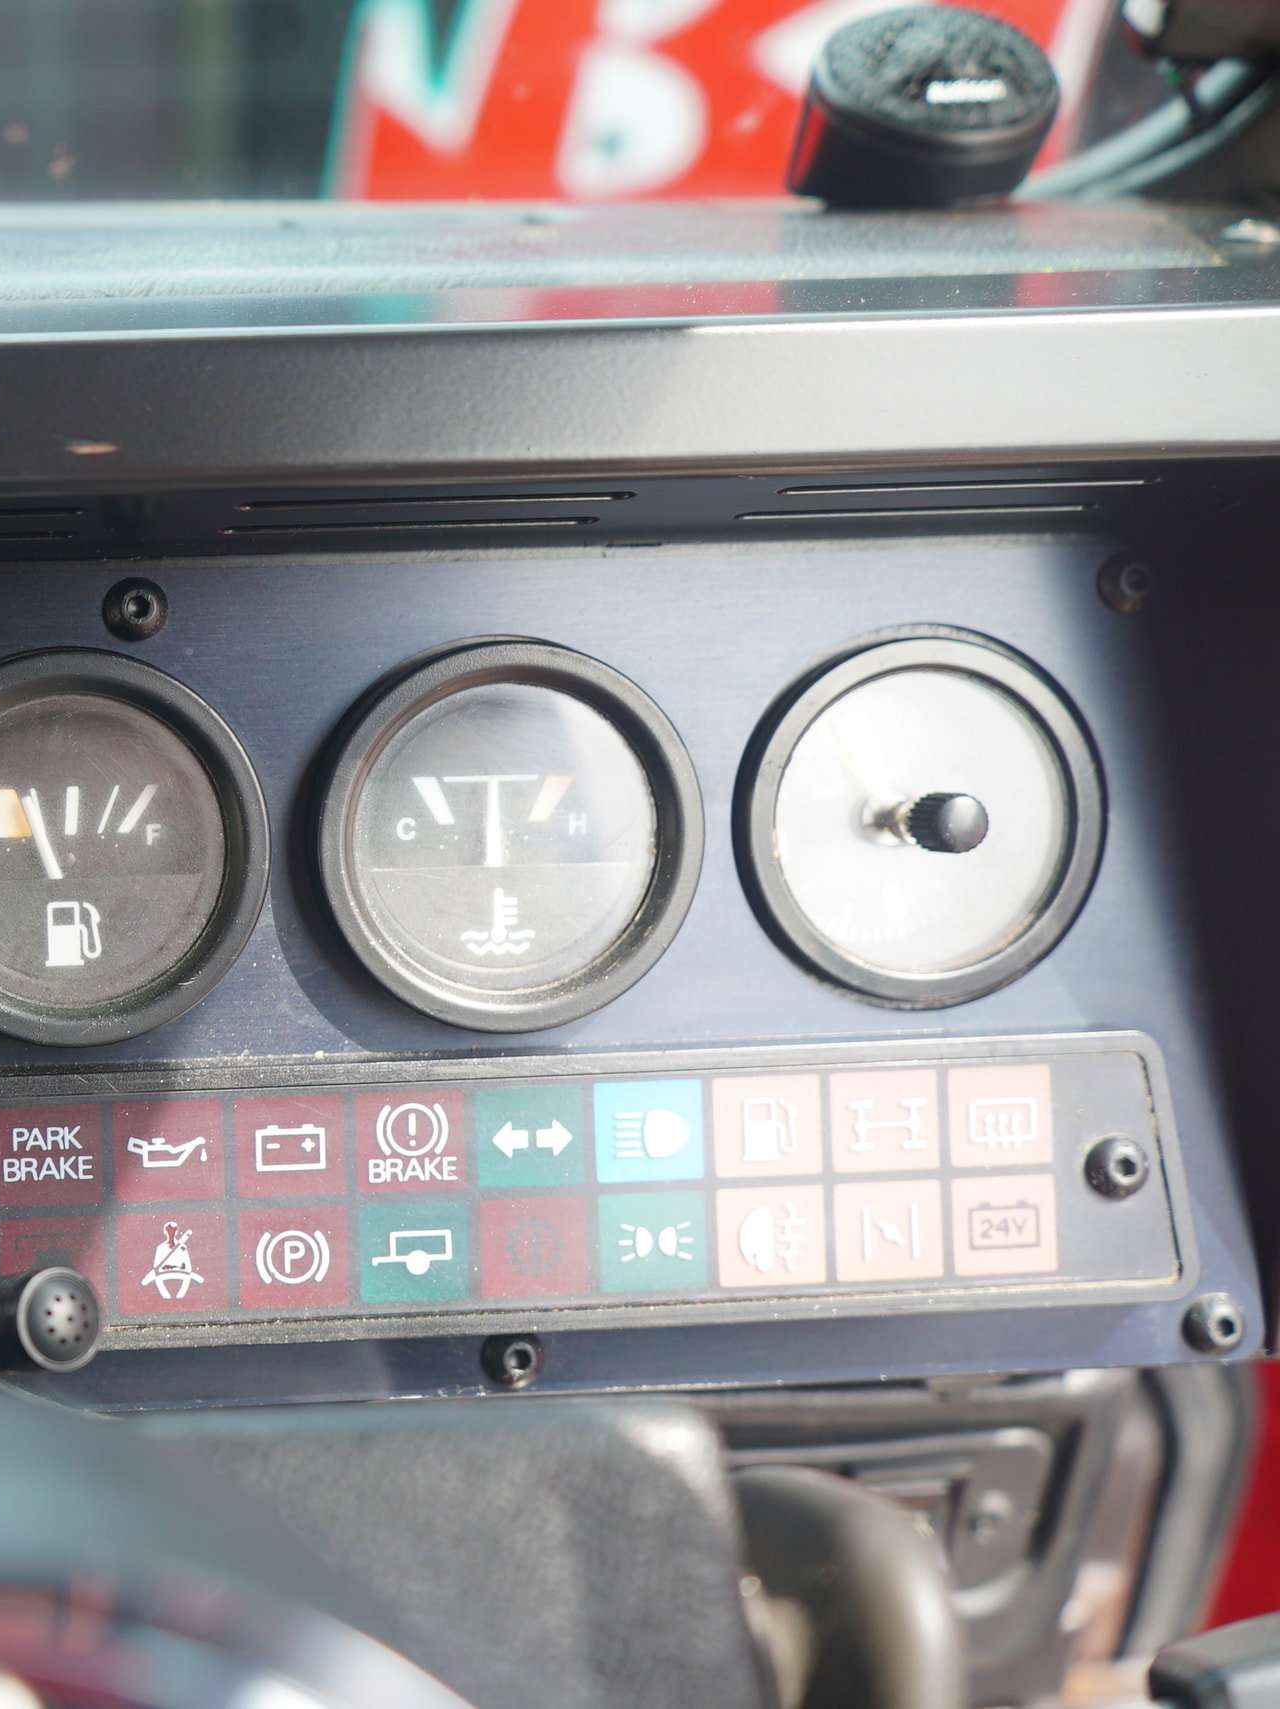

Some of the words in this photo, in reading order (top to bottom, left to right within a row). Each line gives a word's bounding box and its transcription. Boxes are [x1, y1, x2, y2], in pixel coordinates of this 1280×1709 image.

[146, 823, 162, 846] F
[396, 816, 417, 841] C
[569, 812, 588, 836] H
[12, 1126, 83, 1152] PARK
[3, 1155, 94, 1182] BRAKE
[368, 1156, 458, 1184] BRAKE
[980, 1216, 1027, 1239] 24V
